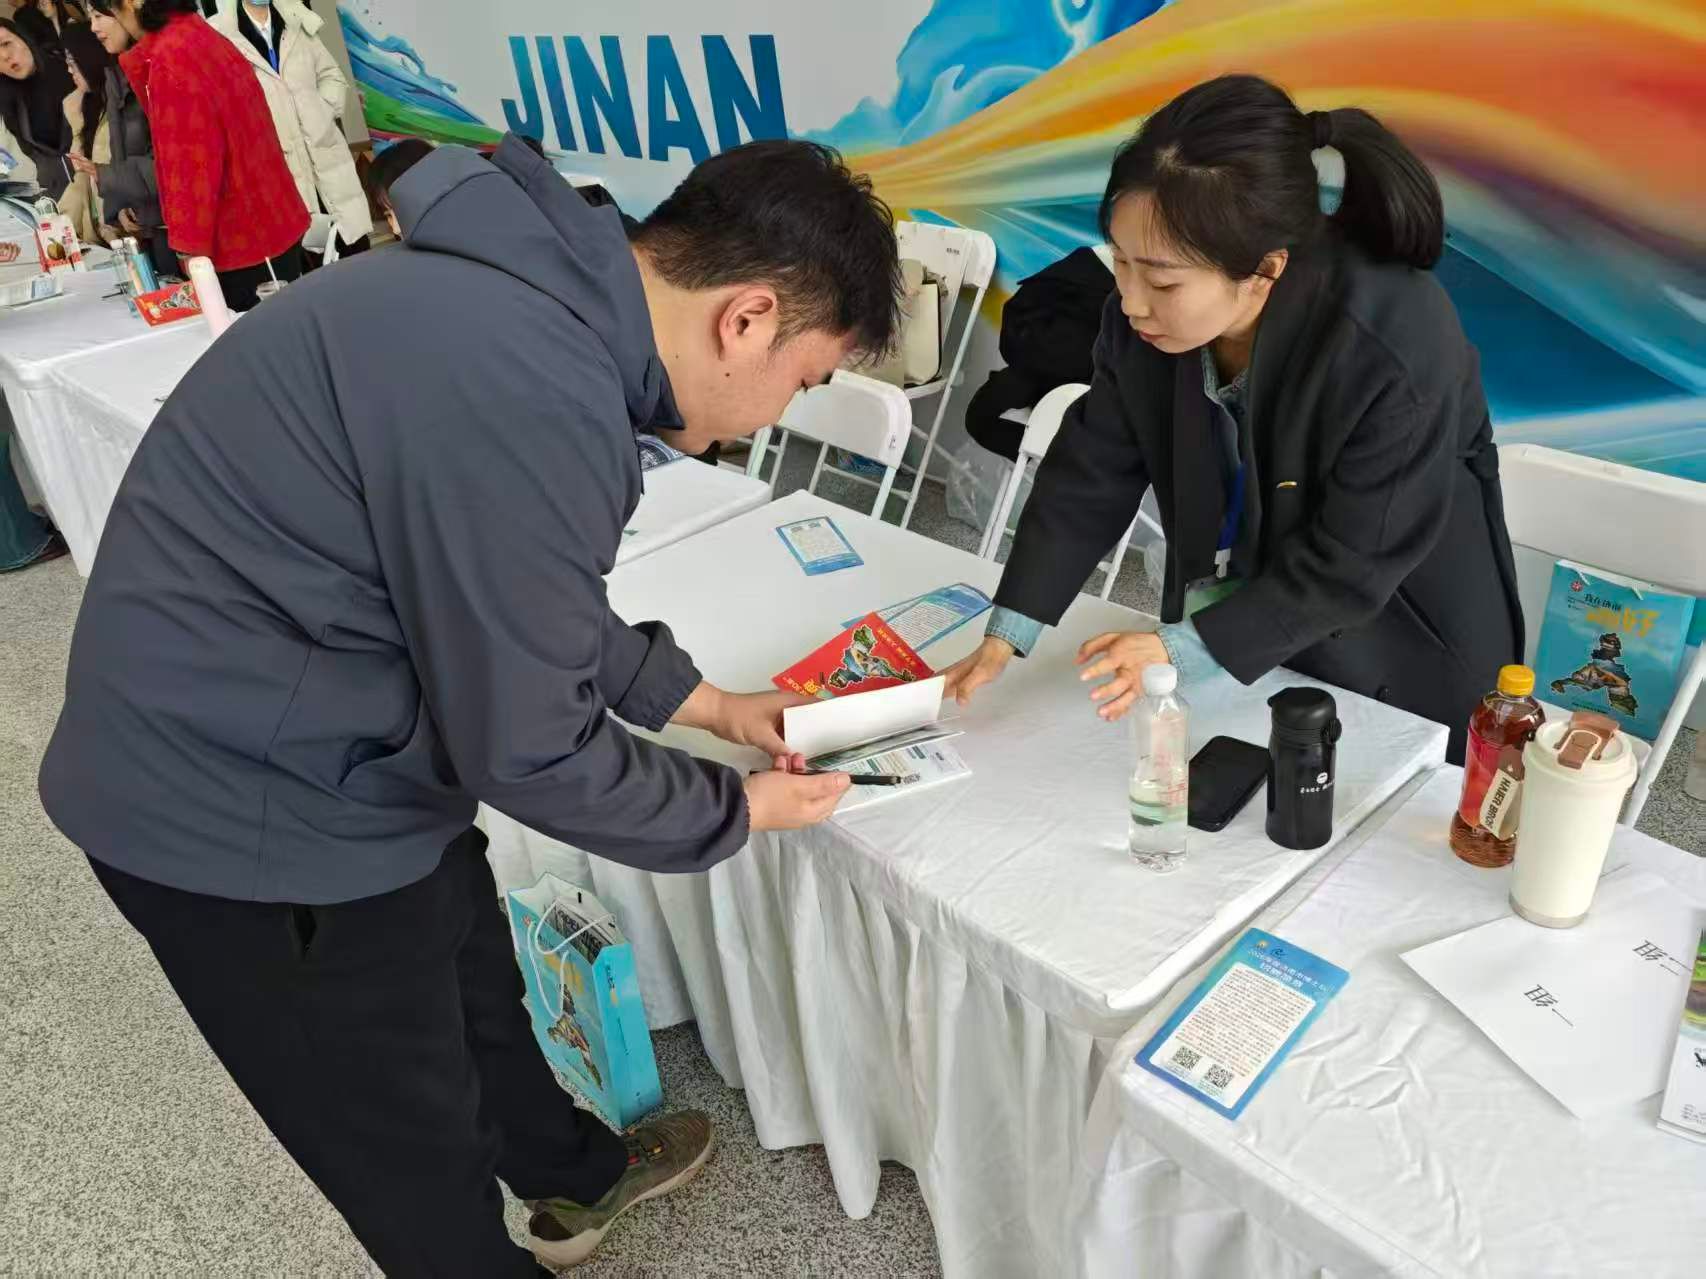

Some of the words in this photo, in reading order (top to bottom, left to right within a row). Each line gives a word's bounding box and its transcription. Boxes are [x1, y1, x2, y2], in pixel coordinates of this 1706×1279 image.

[501, 35, 788, 165] JINAN
[1491, 777, 1512, 806] HAIER
[1523, 983, 1574, 1028] 一组
